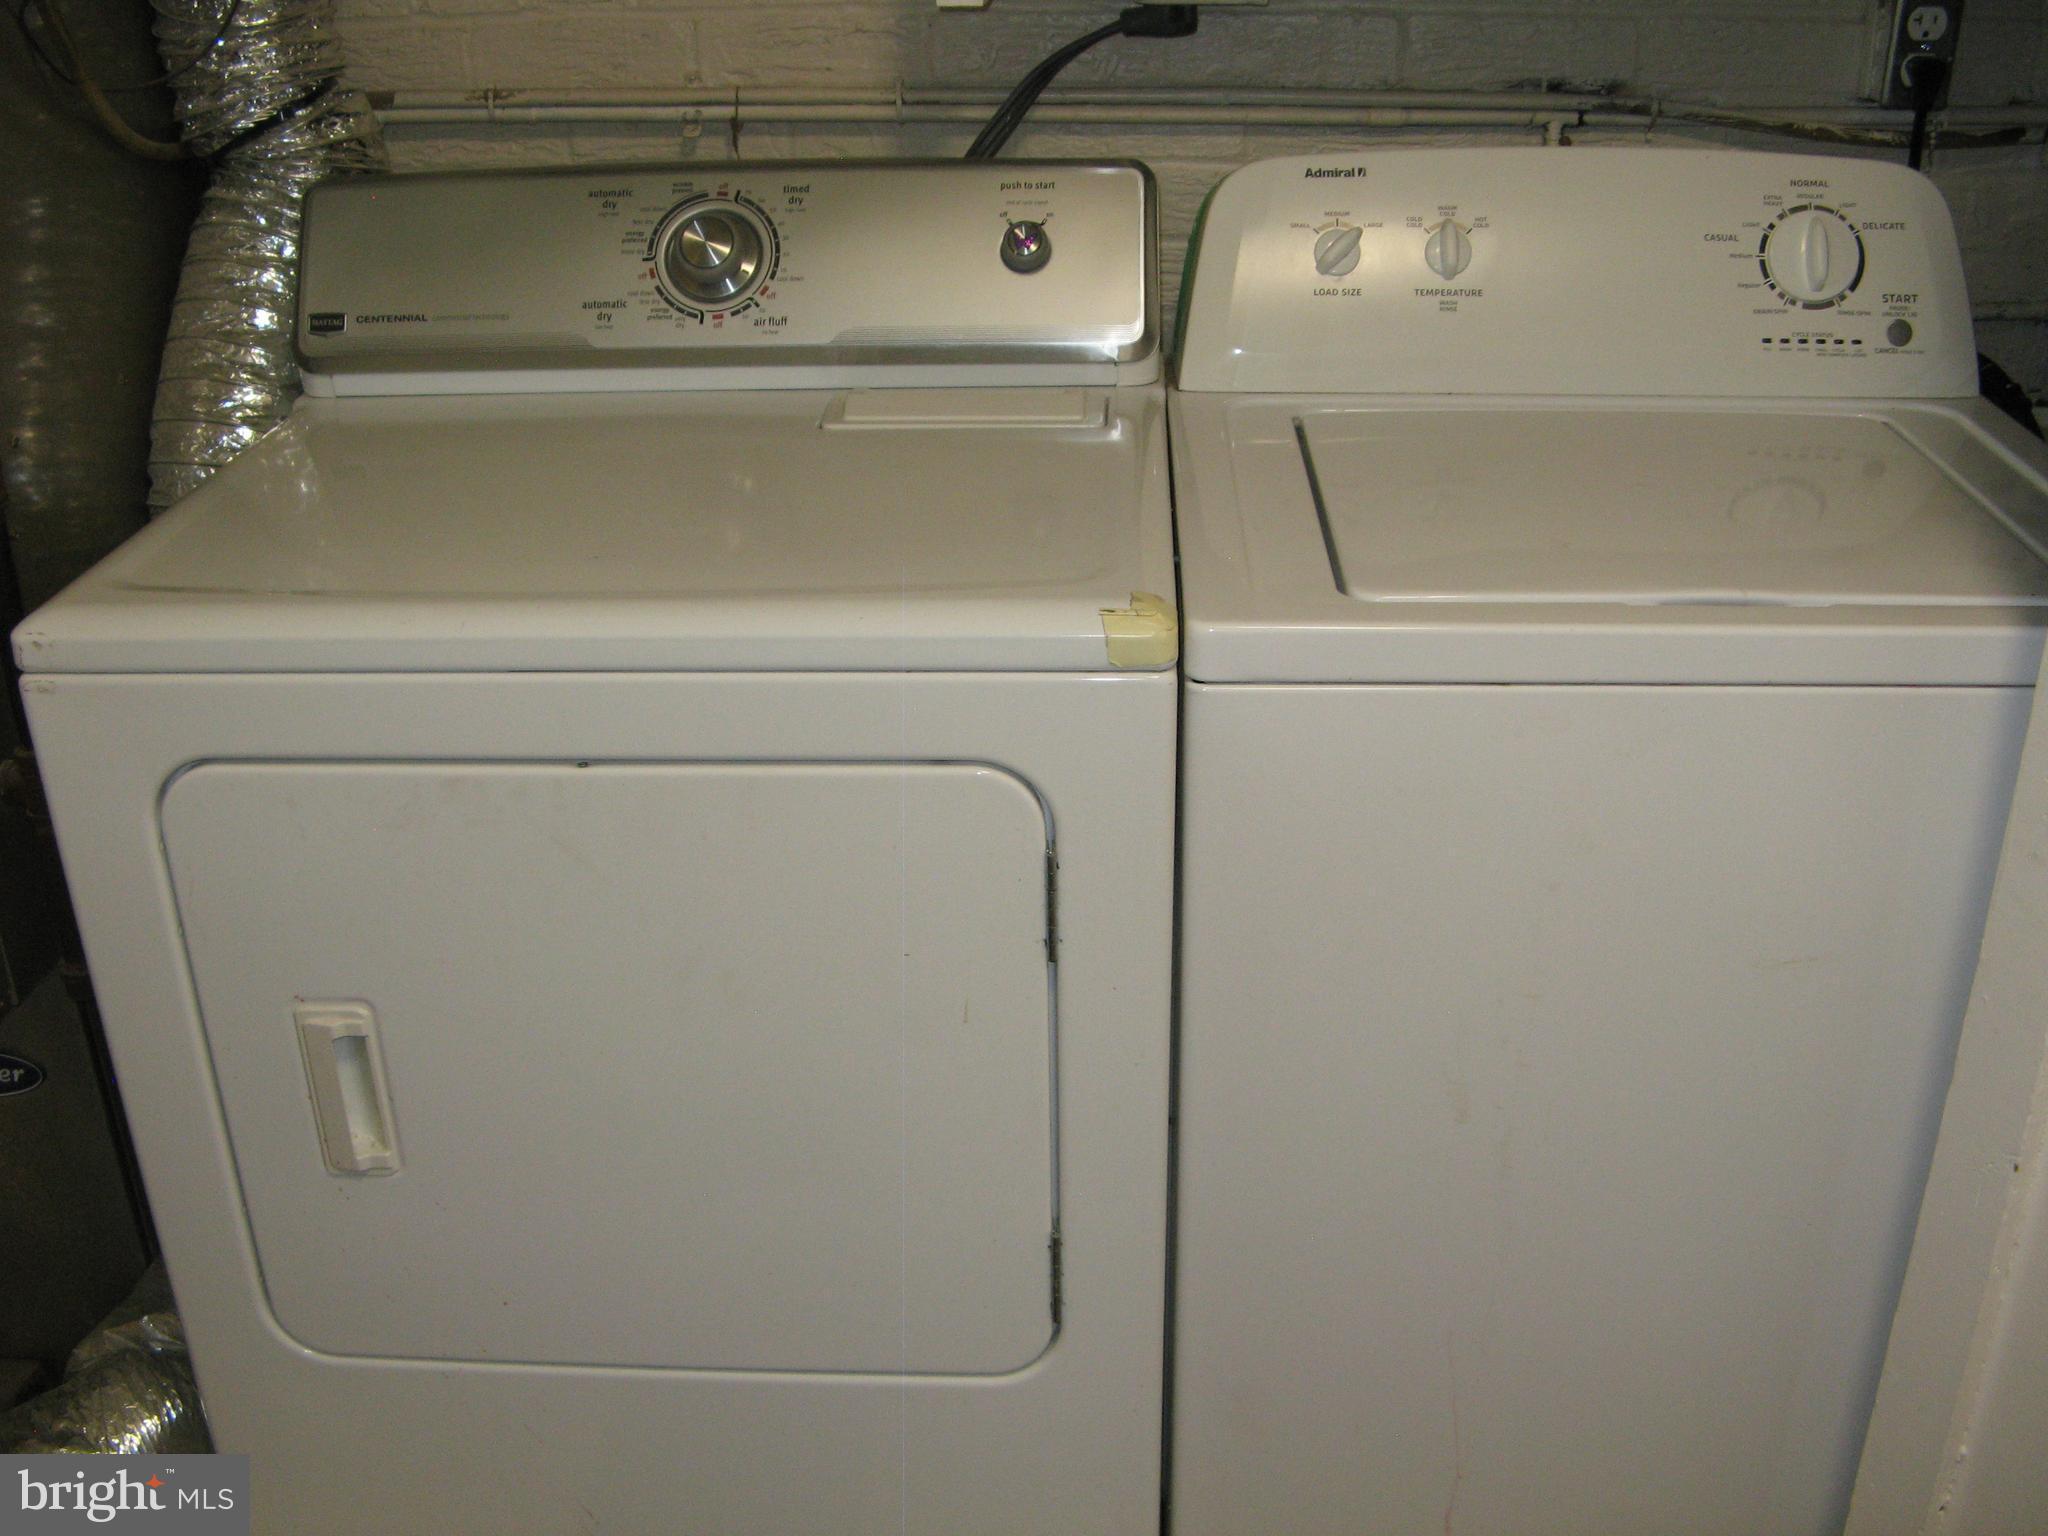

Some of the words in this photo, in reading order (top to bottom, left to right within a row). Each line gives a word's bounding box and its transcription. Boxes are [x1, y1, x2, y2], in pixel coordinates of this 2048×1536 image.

[1304, 167, 1355, 178] Admiral
[783, 184, 810, 193] timed
[1000, 181, 1021, 191] push
[1024, 181, 1033, 190] to
[1035, 181, 1055, 190] start
[1790, 179, 1829, 188] NORMAL
[588, 188, 633, 198] automatic
[602, 199, 617, 209] dry
[788, 195, 804, 206] dry
[1862, 222, 1905, 231] DELICATE
[1704, 233, 1739, 242] CASUAL
[1313, 288, 1338, 297] LOAD
[1341, 288, 1362, 297] SIZE
[1414, 288, 1484, 297] TEMPERATURE
[1882, 293, 1919, 304] START
[581, 300, 628, 309] automatic
[356, 313, 428, 324] CENTENNIAL
[597, 311, 612, 322] dry
[753, 316, 766, 327] air
[768, 315, 788, 327] fluff
